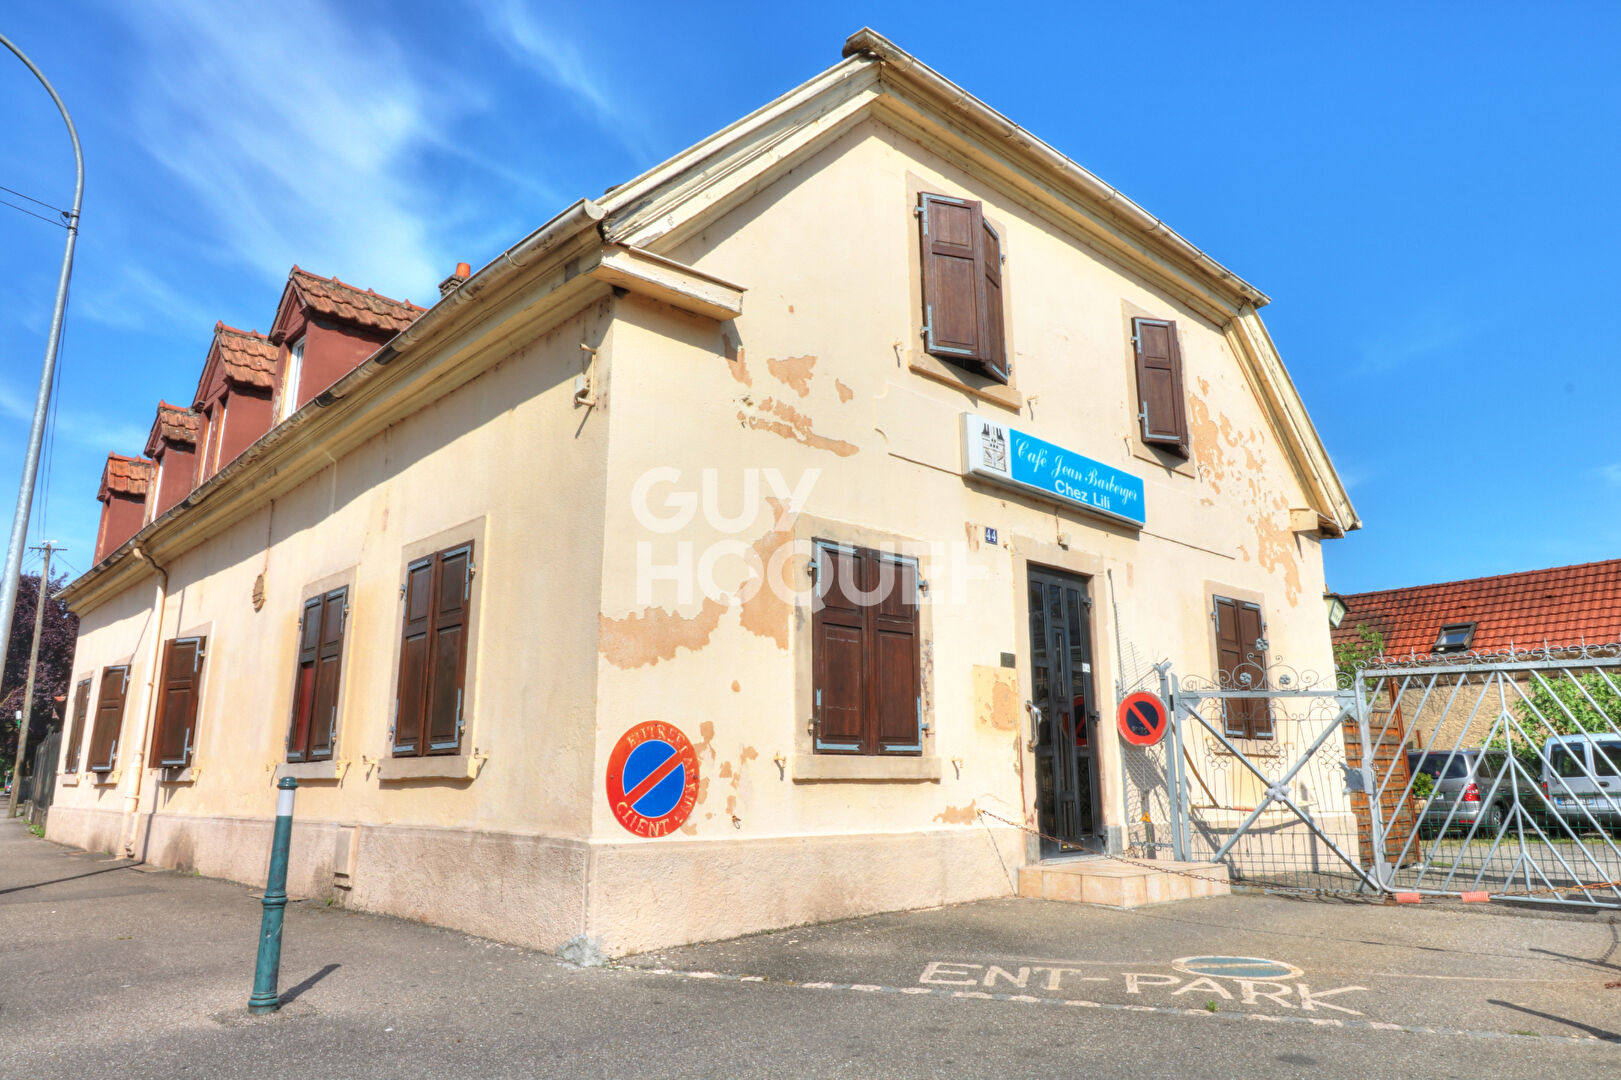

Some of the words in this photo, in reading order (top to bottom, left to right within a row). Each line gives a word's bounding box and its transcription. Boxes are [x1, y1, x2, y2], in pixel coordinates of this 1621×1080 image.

[1015, 438, 1048, 473] Café
[1051, 455, 1083, 483] Jean
[1055, 479, 1088, 502] Chez
[1093, 491, 1111, 510] Lili
[985, 528, 997, 542] 44
[616, 801, 669, 837] CLIENT
